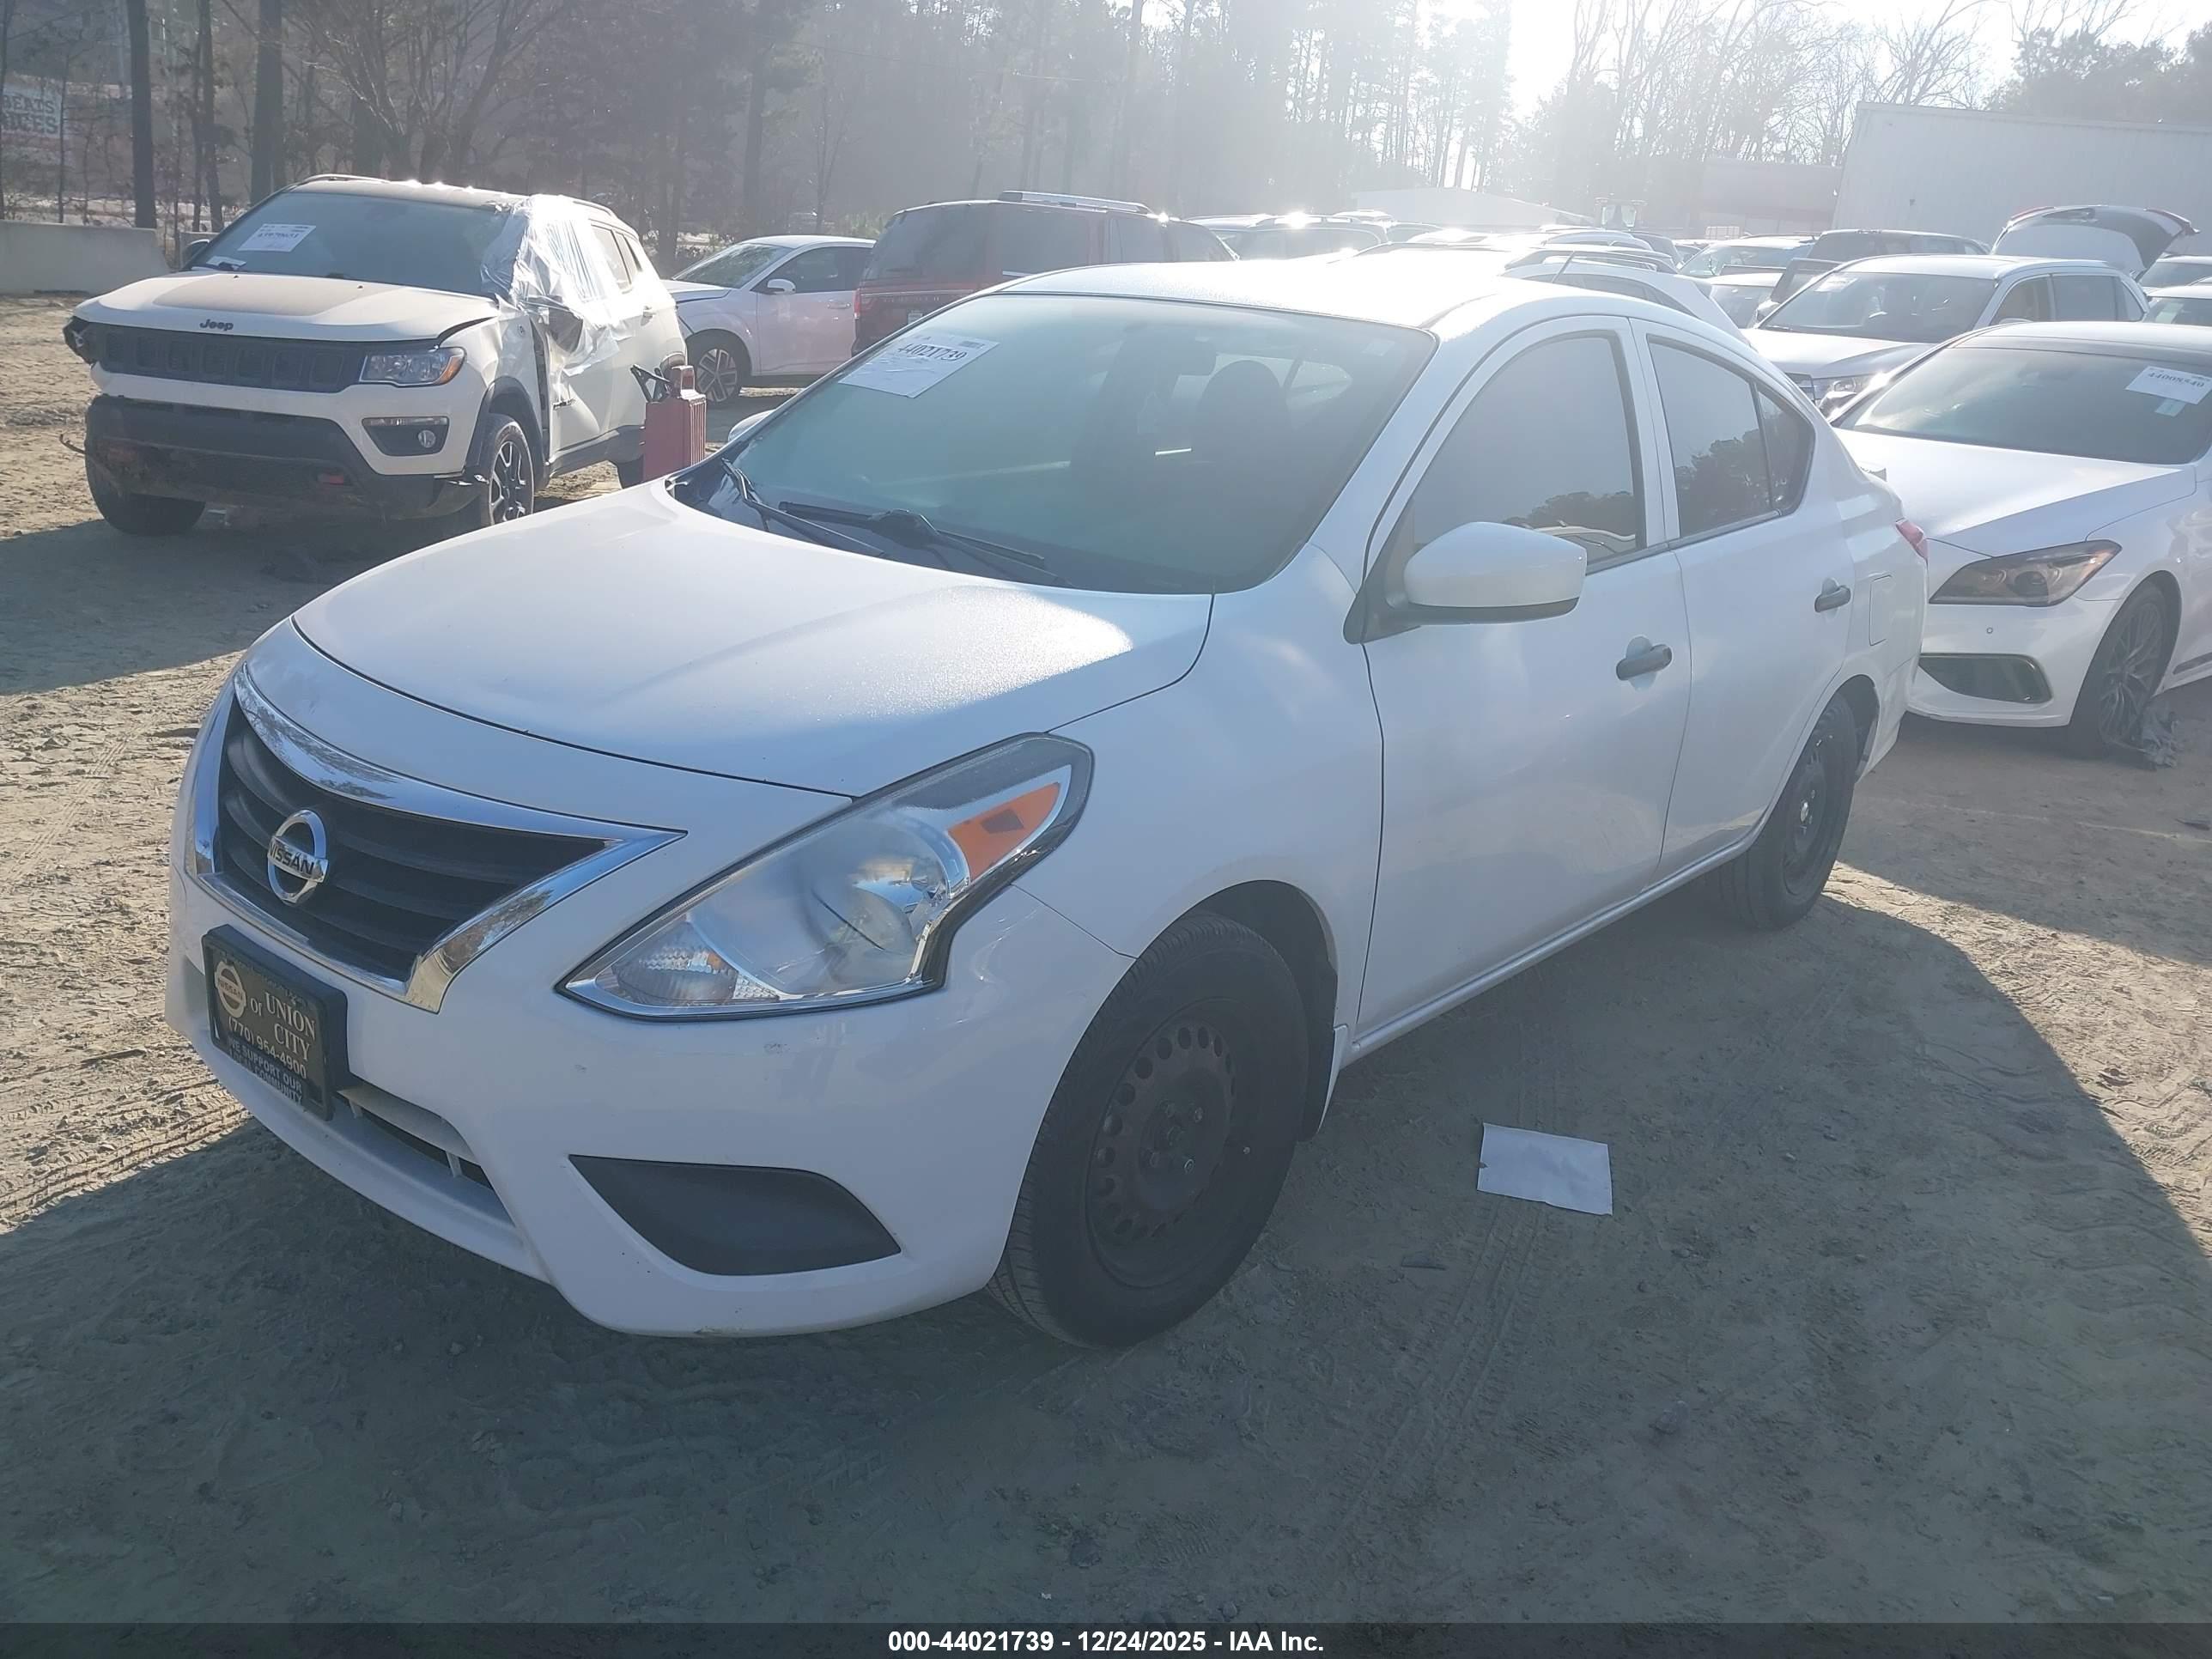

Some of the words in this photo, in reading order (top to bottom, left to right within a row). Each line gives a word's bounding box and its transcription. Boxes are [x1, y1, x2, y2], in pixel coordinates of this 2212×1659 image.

[199, 319, 234, 331] Jeep
[269, 840, 314, 874] NISSAN
[264, 991, 315, 1041] UNION
[228, 1015, 254, 1045] (770)
[256, 1035, 307, 1079] 954-4900
[274, 1023, 310, 1061] CITY
[241, 1044, 281, 1079] SUPPORT
[283, 1073, 302, 1094] OUR
